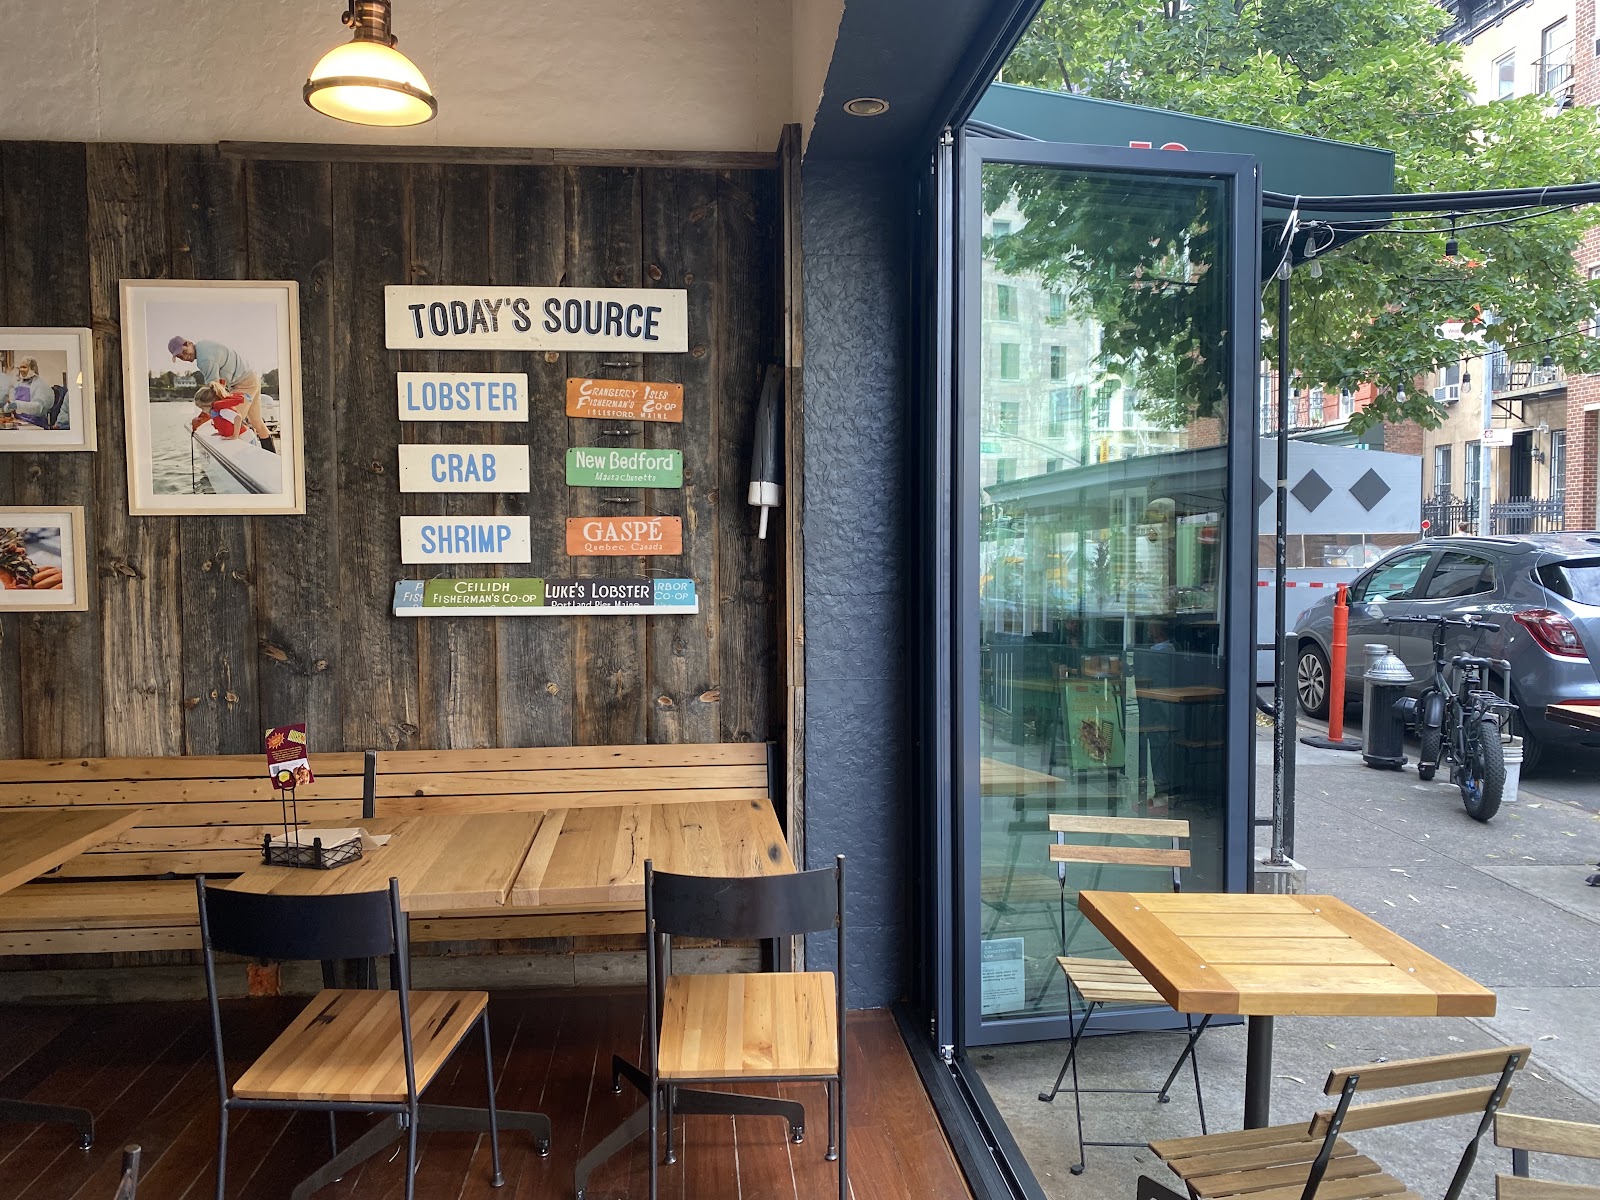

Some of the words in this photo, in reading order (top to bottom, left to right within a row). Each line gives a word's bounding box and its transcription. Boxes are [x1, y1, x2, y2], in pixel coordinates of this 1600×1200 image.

[408, 297, 531, 339] TODAY'S
[543, 297, 662, 341] SOURCE
[407, 381, 517, 411] LOBSTER
[580, 380, 638, 398] CRANBERRY
[644, 385, 668, 399] ISLES
[576, 396, 635, 409] FISHERMAN'S
[642, 399, 677, 412] CO-OP
[431, 453, 497, 483] CRAB
[576, 451, 606, 468] New
[609, 451, 674, 471] Bedford
[594, 472, 656, 482] Massachusetts
[421, 524, 512, 554] SHRIMP
[583, 517, 663, 542] GASPÉ
[631, 542, 663, 551] Canada
[454, 581, 510, 594] CEILIDH
[545, 582, 585, 598] LUKE'S
[592, 582, 650, 598] LOBSTER
[433, 593, 500, 604] FISHERMAN'S
